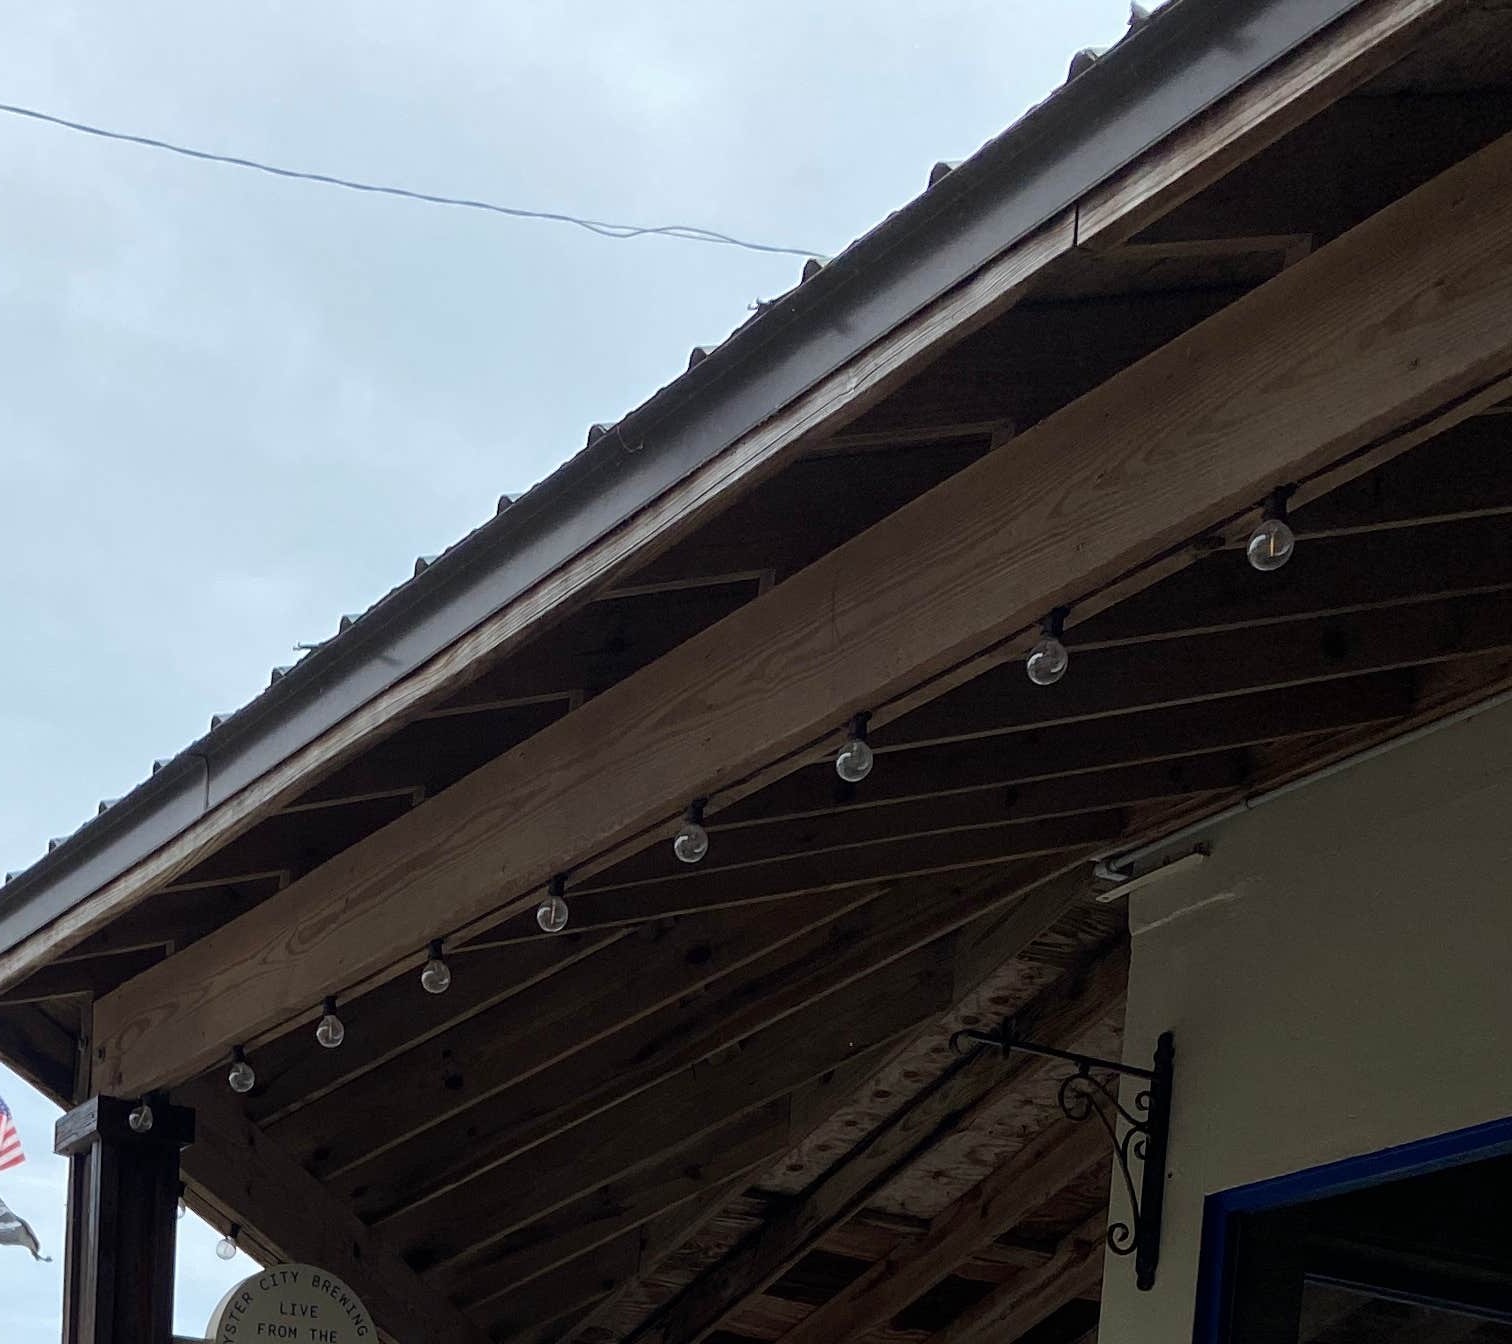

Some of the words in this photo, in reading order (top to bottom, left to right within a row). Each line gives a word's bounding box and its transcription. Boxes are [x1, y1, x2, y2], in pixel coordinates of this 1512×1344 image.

[259, 1271, 300, 1291] CITY
[311, 1274, 369, 1337] BREWING
[279, 1301, 319, 1318] LIVE
[257, 1322, 298, 1338] FROM
[309, 1328, 337, 1344] THE
